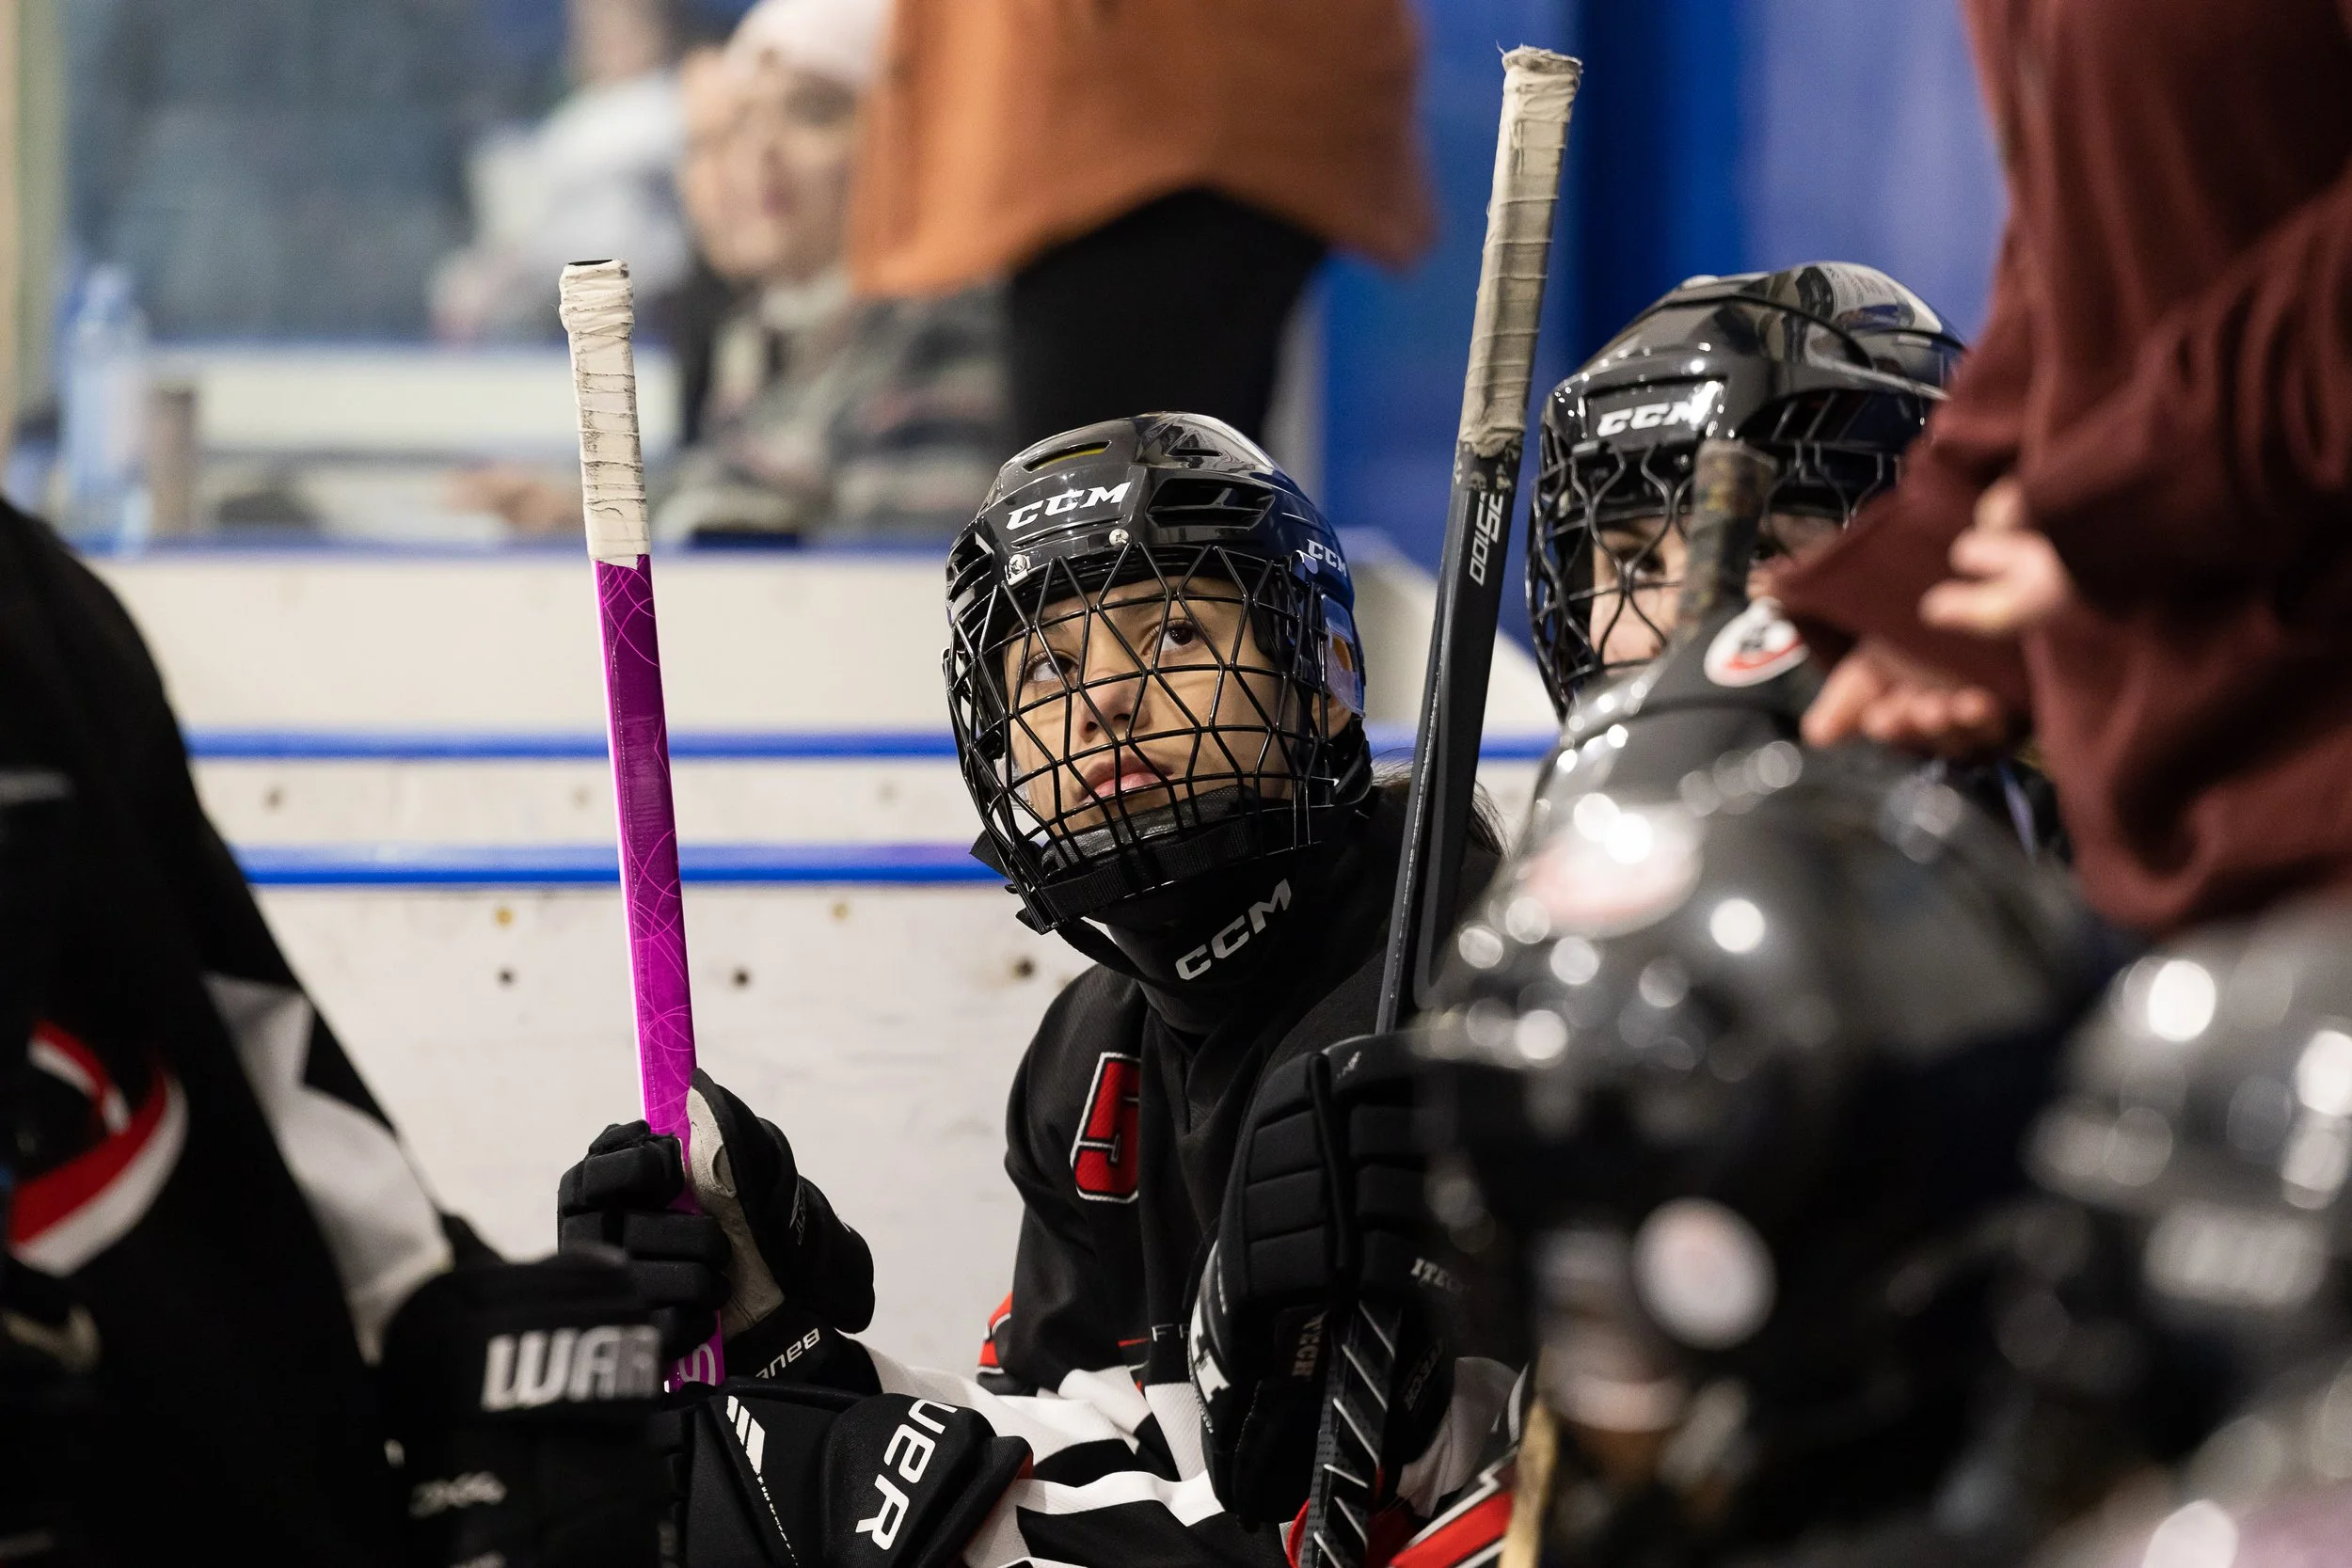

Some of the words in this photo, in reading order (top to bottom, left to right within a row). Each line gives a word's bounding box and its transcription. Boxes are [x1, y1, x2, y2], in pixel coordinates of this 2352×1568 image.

[1597, 400, 1716, 437] CCM
[1006, 482, 1132, 531] CCM
[1307, 538, 1347, 578] CCM
[1175, 878, 1292, 980] CCM
